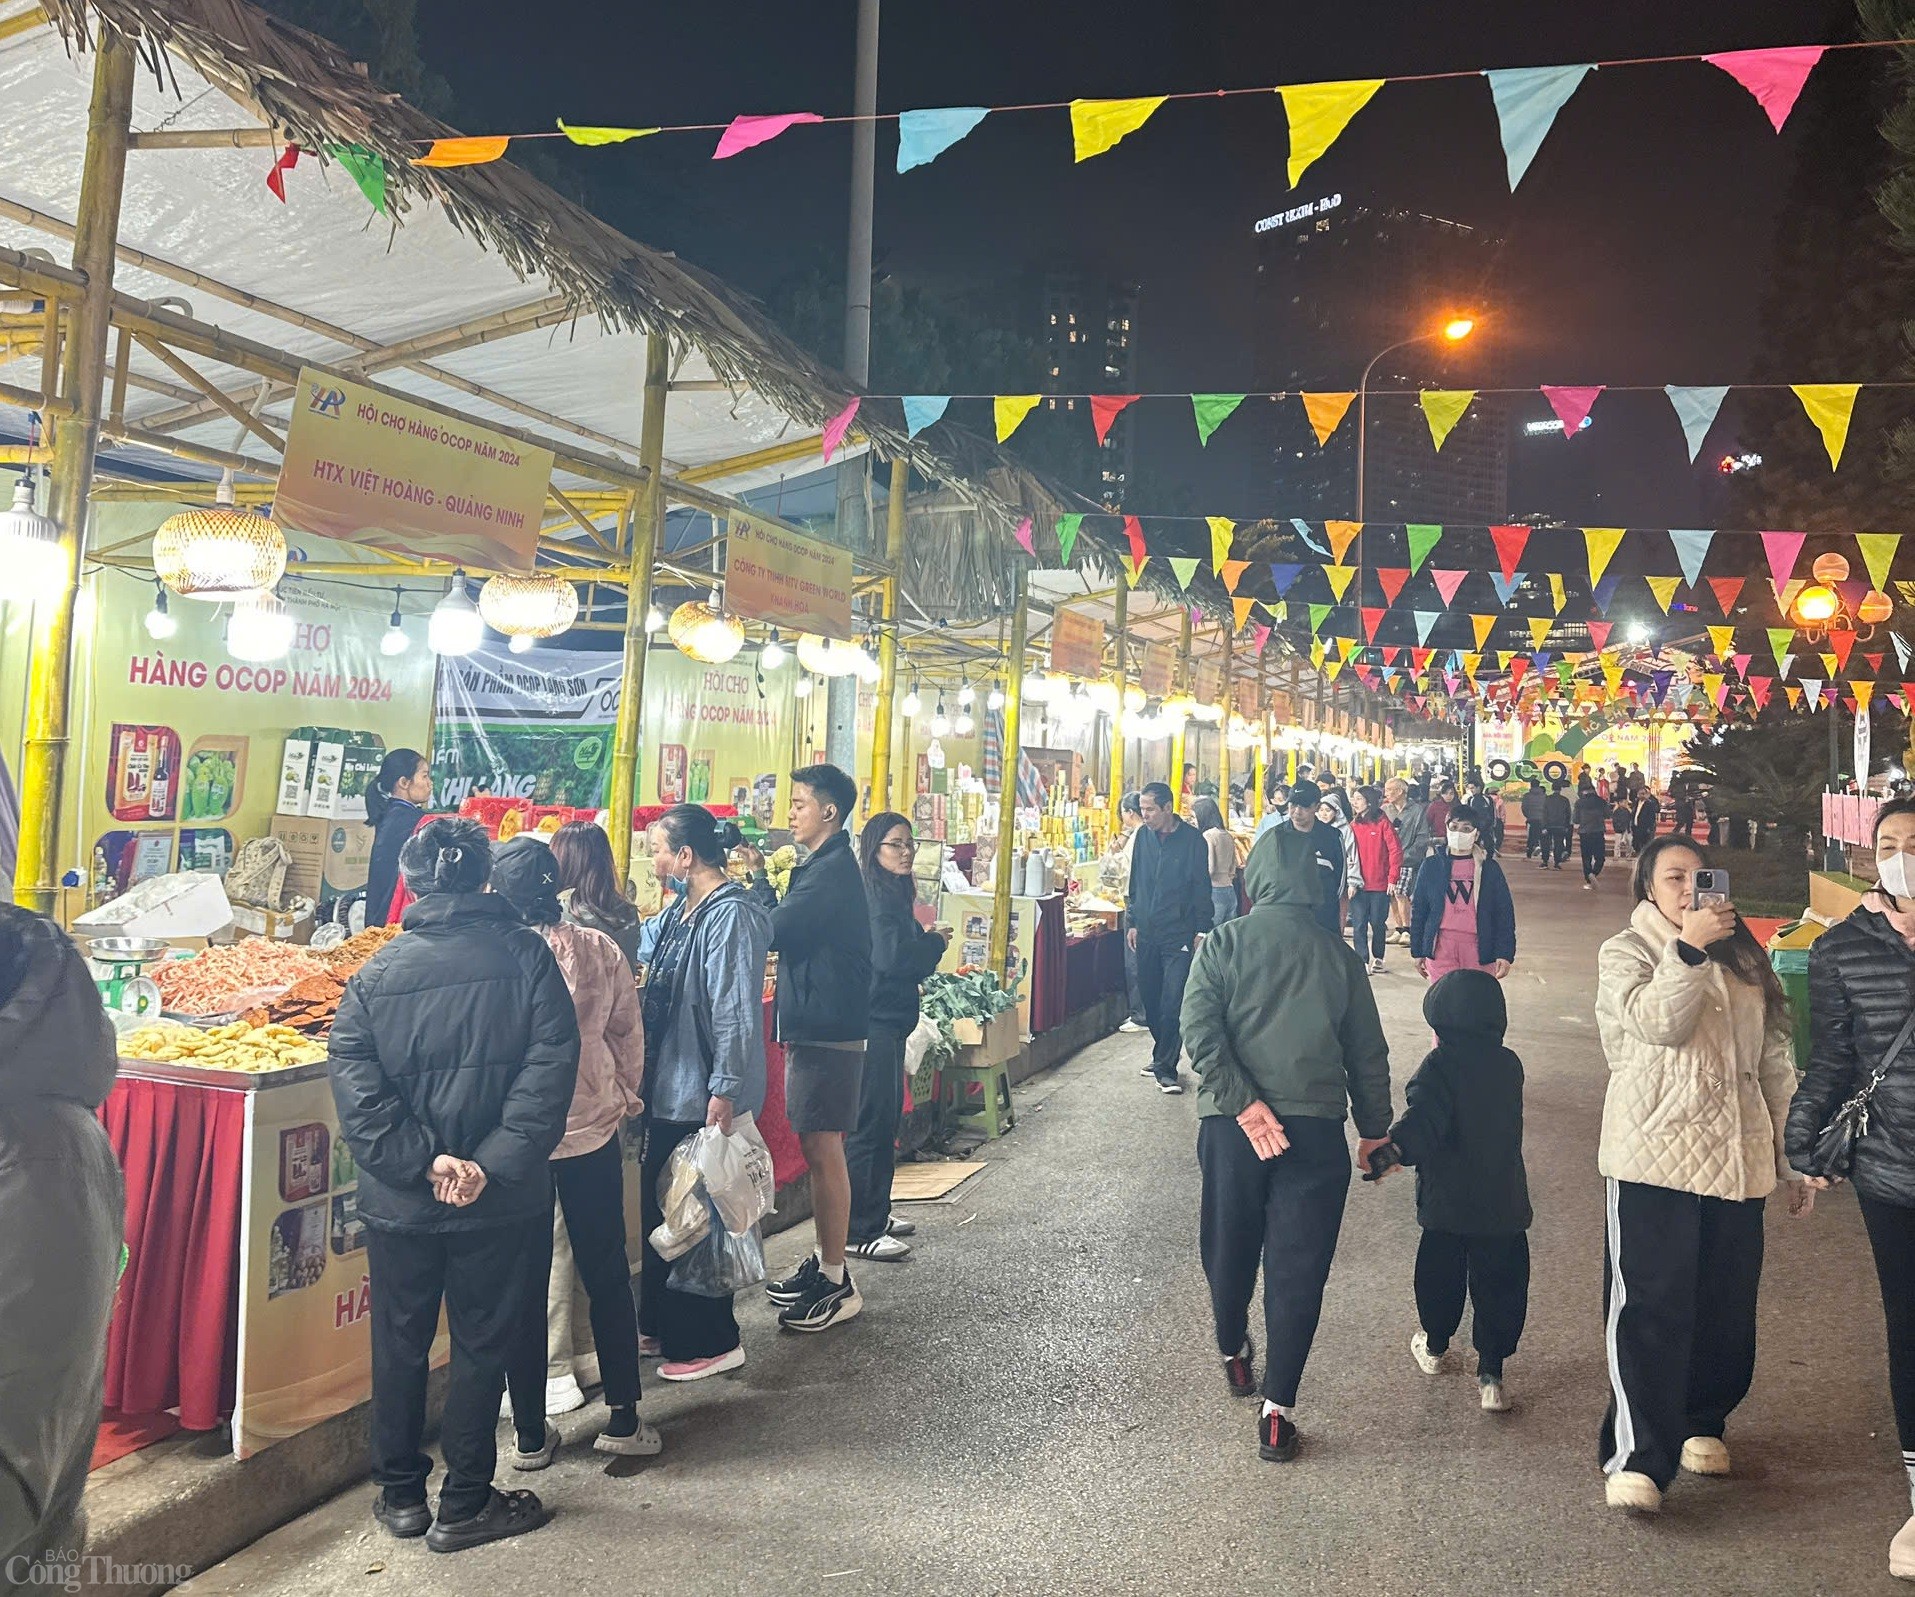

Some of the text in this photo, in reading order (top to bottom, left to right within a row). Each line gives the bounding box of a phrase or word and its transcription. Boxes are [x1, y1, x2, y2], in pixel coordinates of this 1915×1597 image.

[357, 403, 520, 467] HỘI CHỢ HÀNG OCOP NĂM 2024
[313, 459, 345, 484] HTX
[350, 468, 380, 496] VIỆT
[382, 478, 435, 506] HOÀNG
[445, 493, 493, 521] QUẢNG
[496, 508, 526, 528] NINH
[799, 581, 822, 596] GREEN
[292, 622, 332, 657] HỢ
[129, 650, 392, 702] HÀNG OCOP NĂM 2024
[517, 674, 541, 695] OCOP
[700, 704, 731, 723] OCOP
[541, 872, 554, 885] X
[1446, 879, 1474, 906] W
